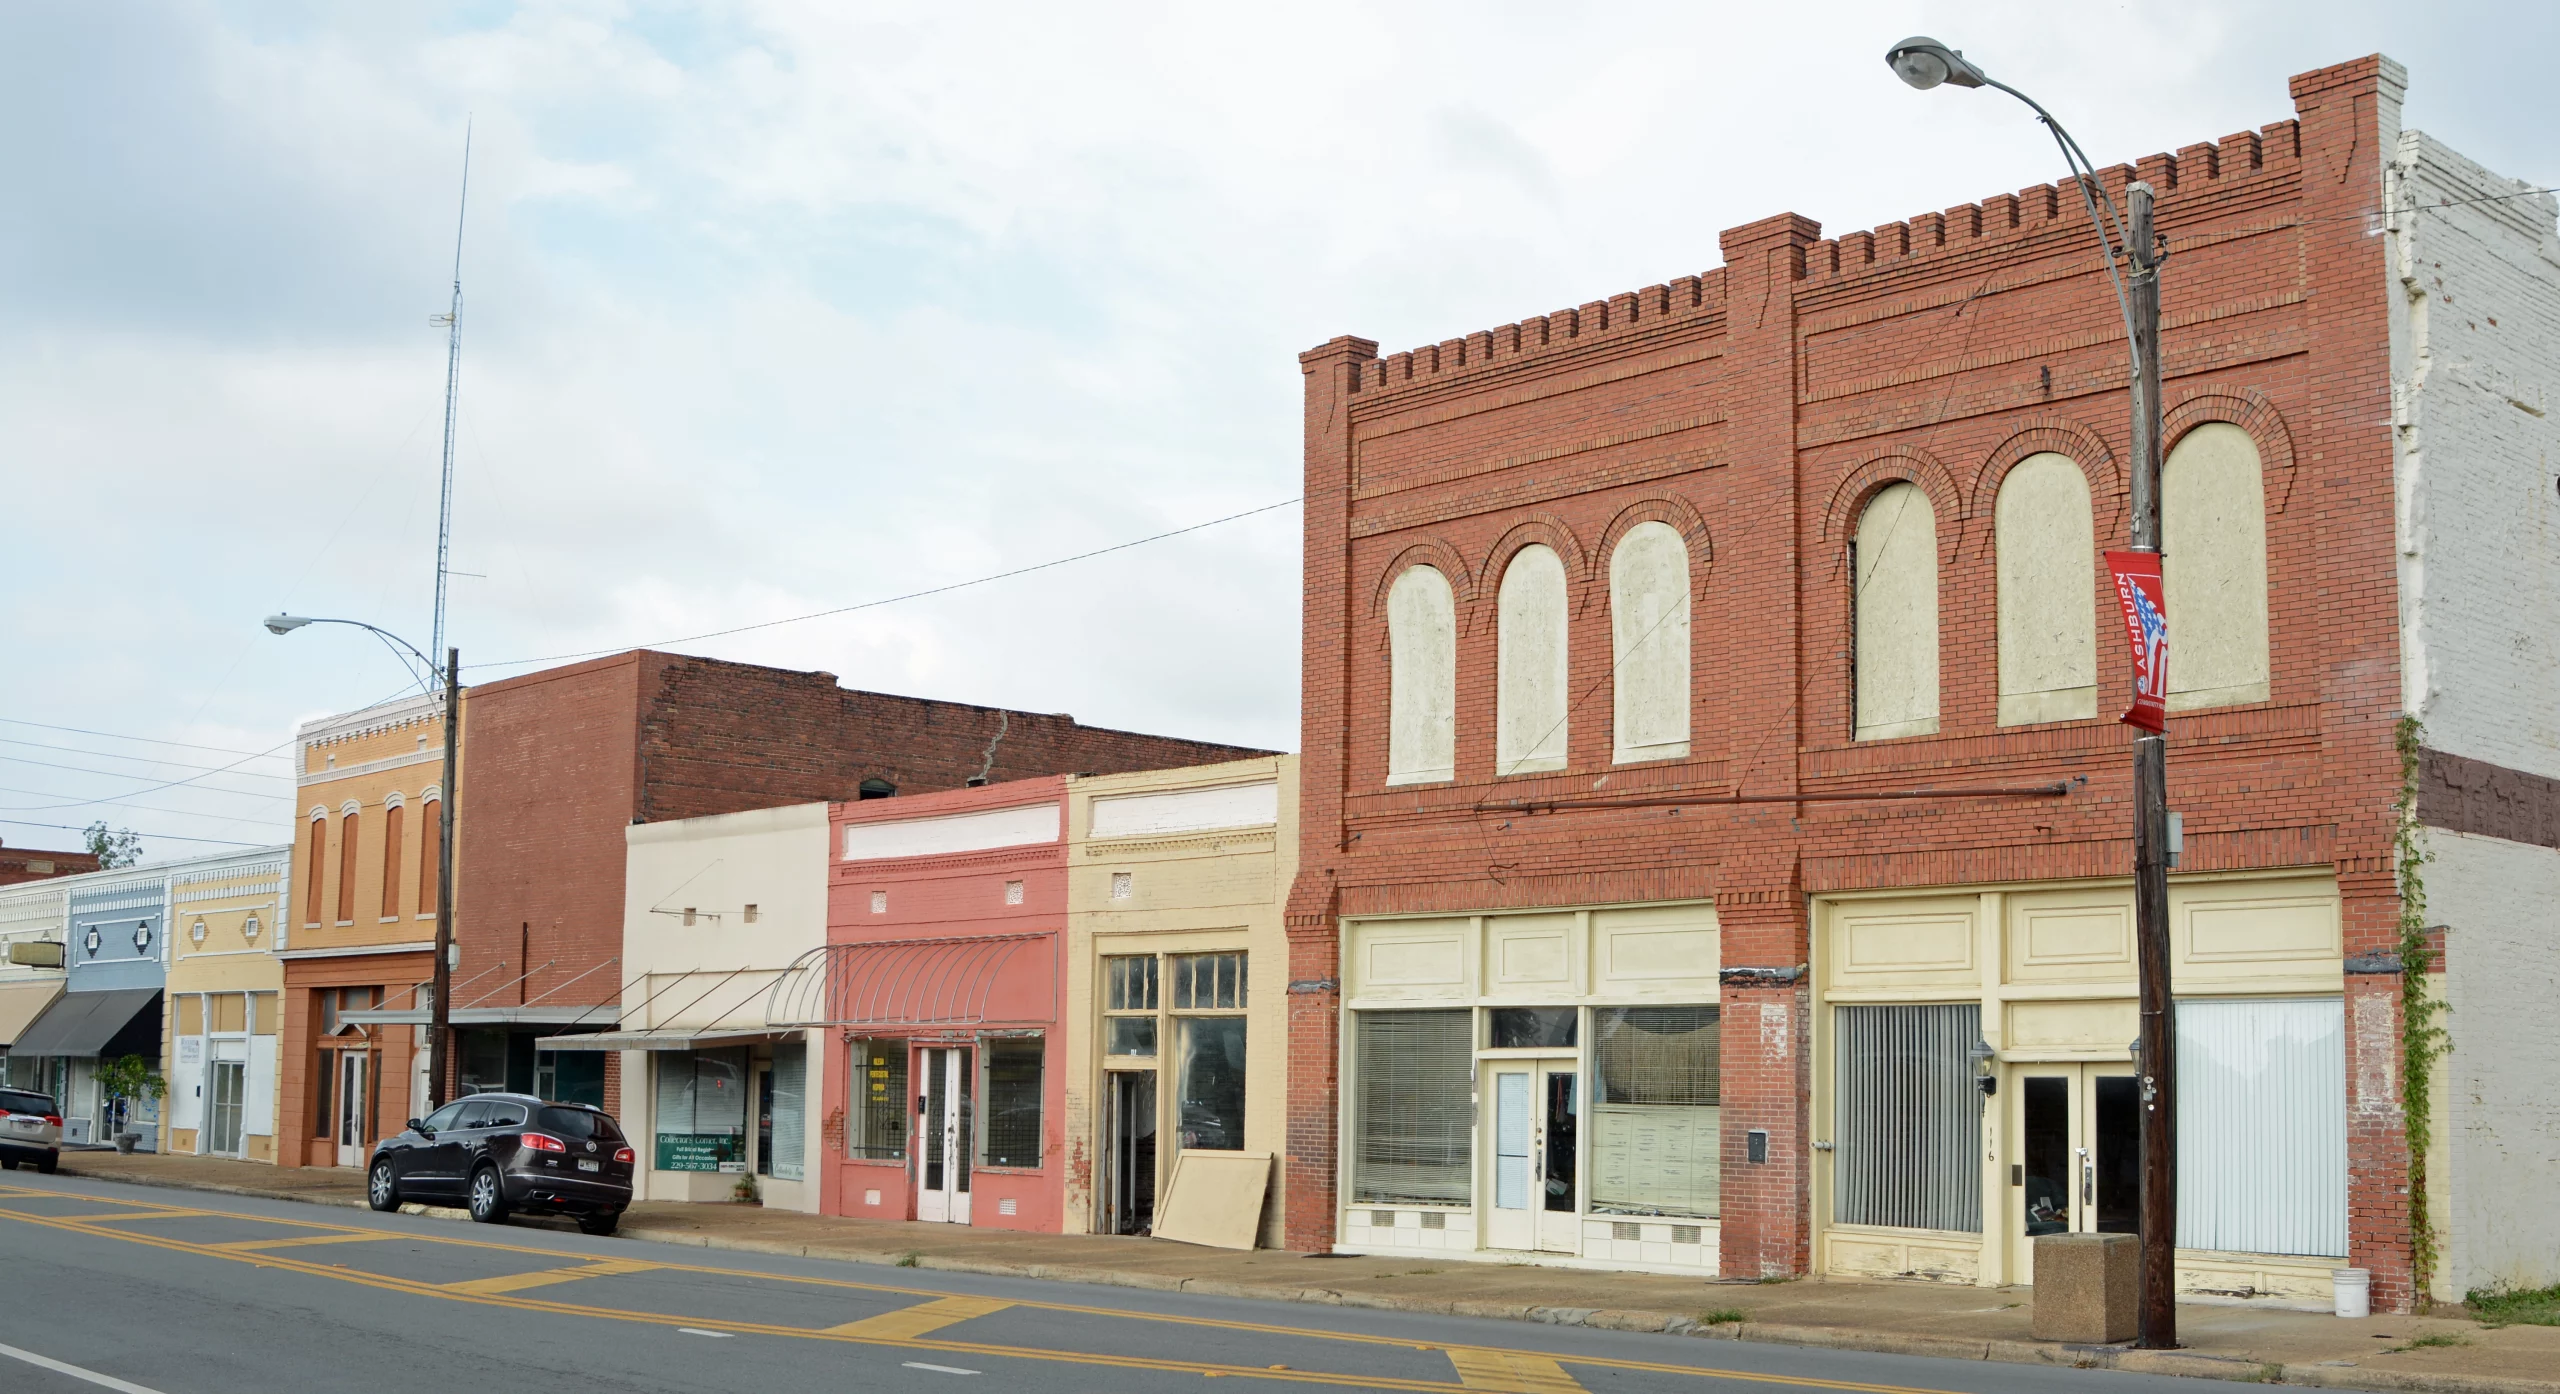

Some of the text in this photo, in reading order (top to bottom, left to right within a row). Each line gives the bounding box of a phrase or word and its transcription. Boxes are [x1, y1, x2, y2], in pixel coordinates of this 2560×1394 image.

[2115, 572, 2147, 670] ASHBURN
[660, 1135, 693, 1144] Collector's
[719, 1137, 731, 1145] Inc.
